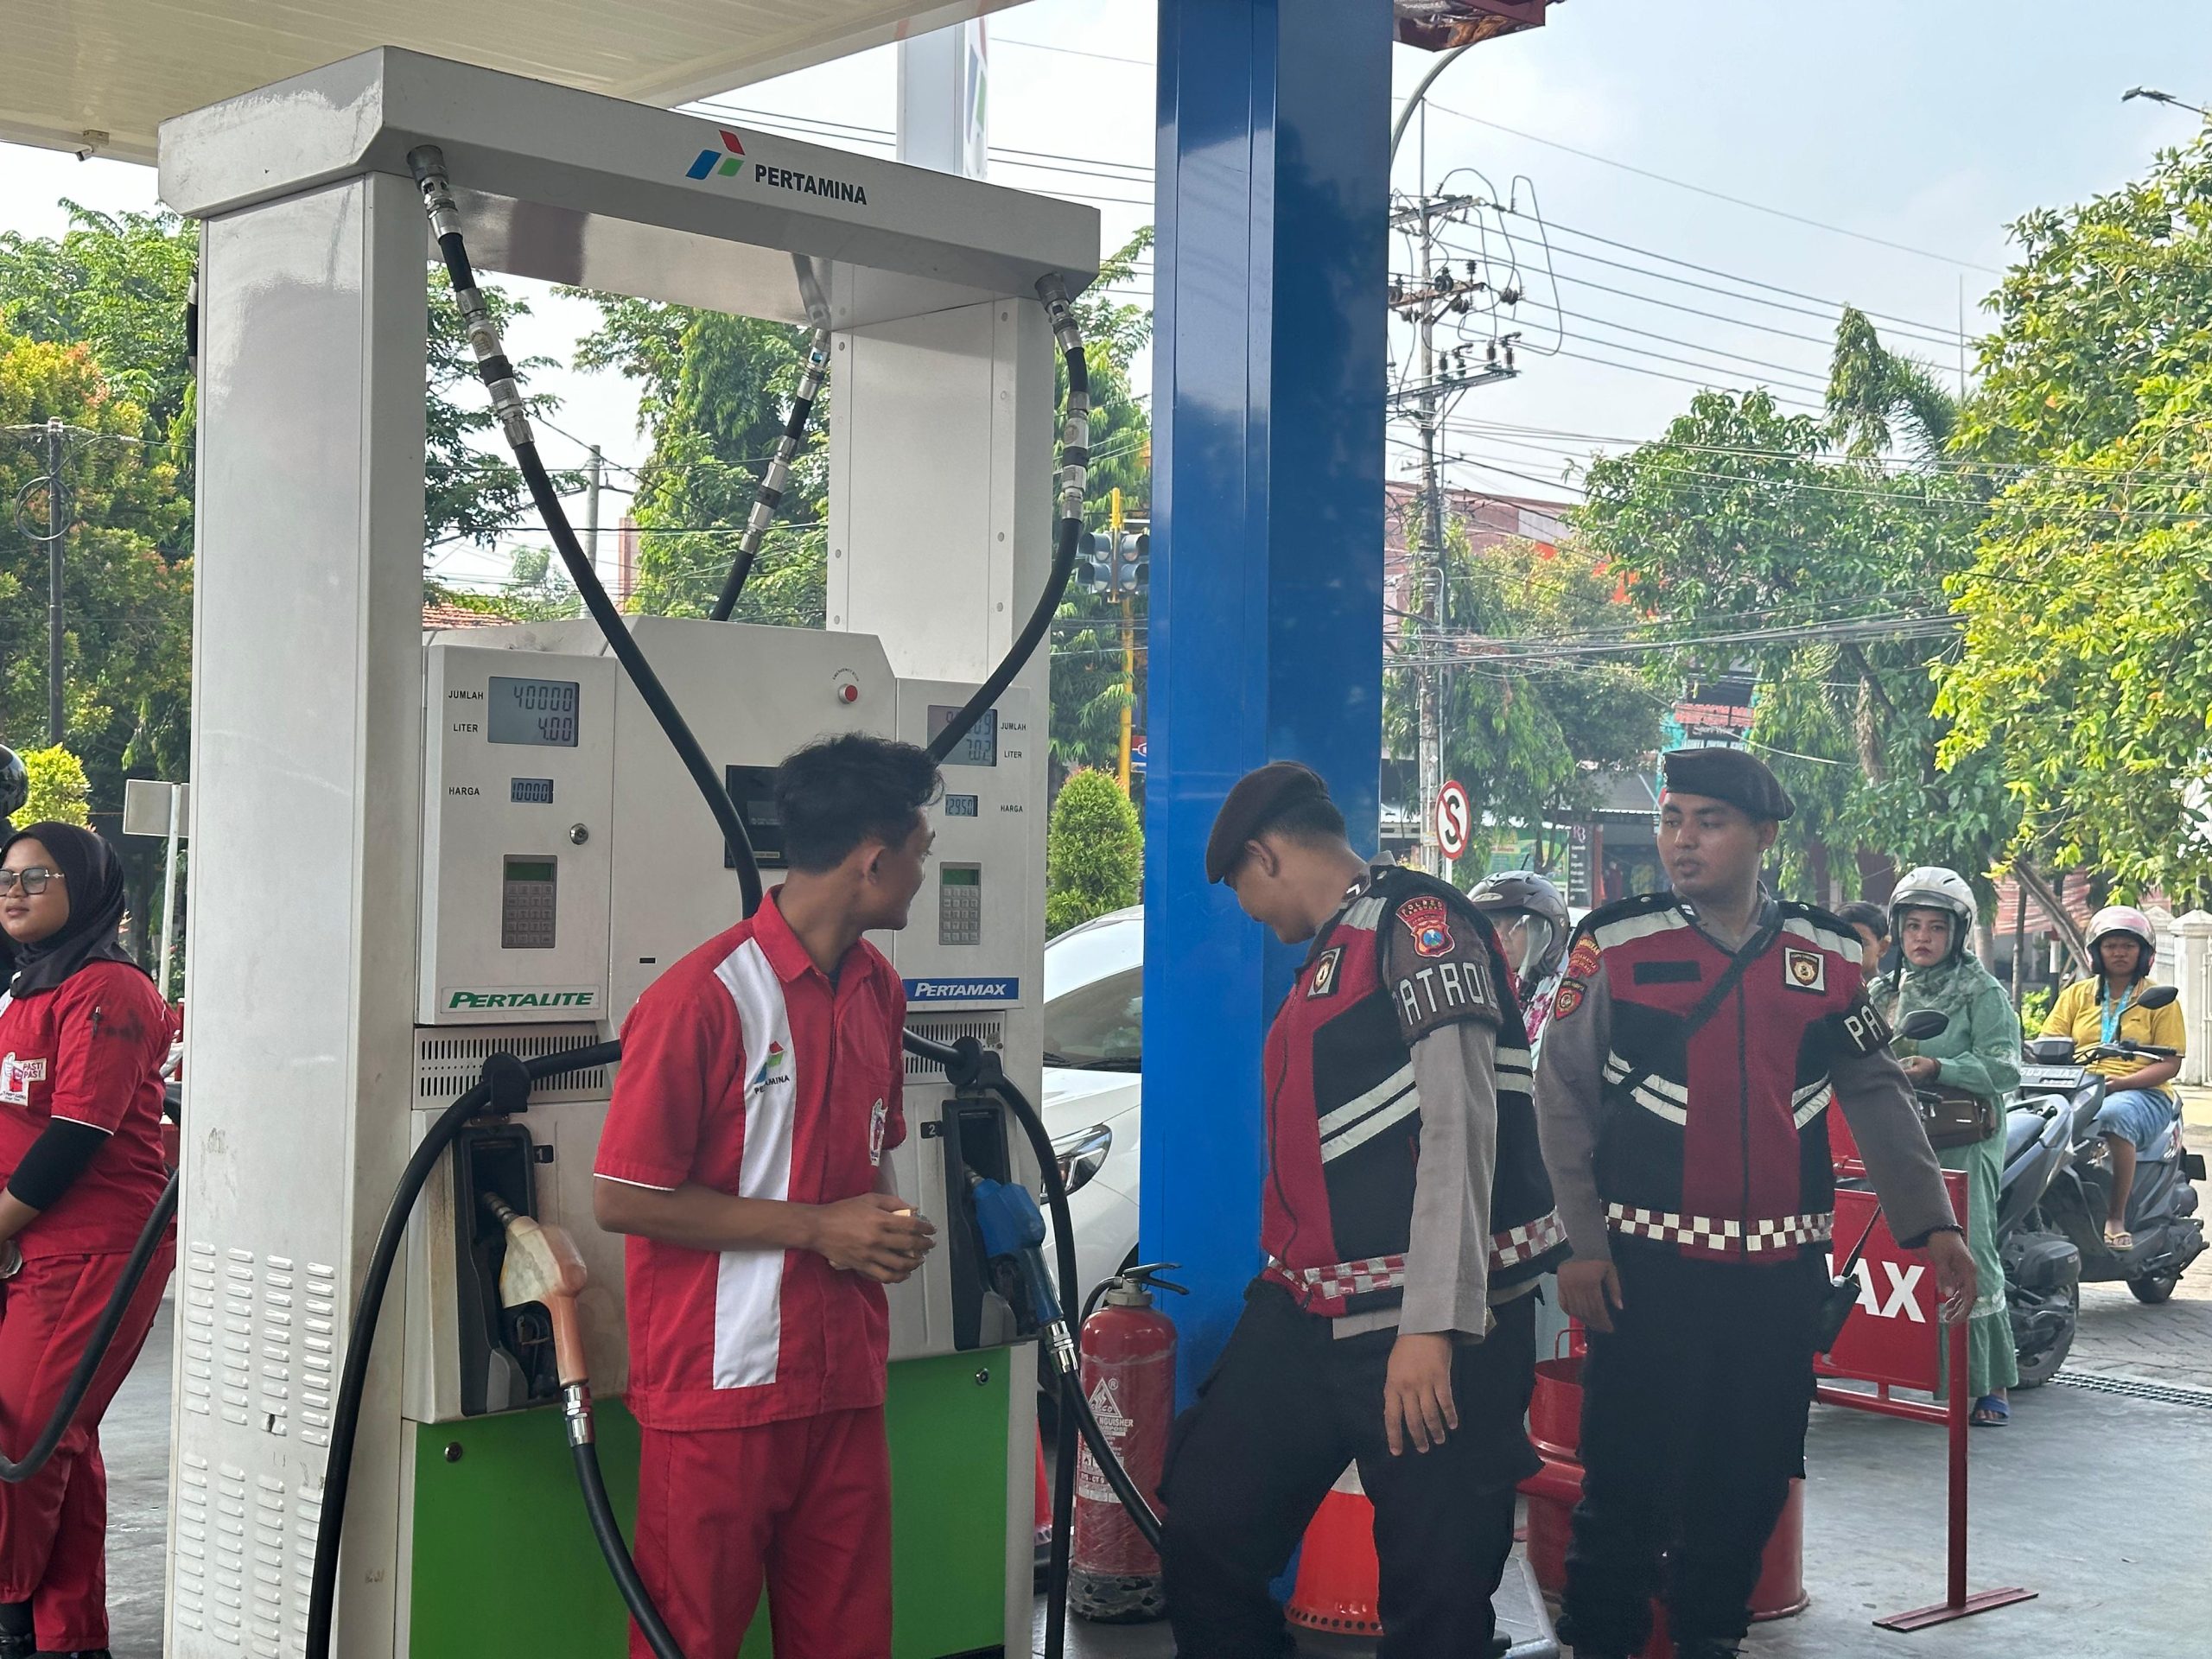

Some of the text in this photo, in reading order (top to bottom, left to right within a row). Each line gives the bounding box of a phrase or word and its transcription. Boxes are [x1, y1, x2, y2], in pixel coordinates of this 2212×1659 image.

[755, 163, 867, 206] PERTAMINA
[448, 690, 484, 700] JUMLAH
[514, 685, 574, 712] 40000
[453, 723, 479, 733] LITER
[538, 717, 573, 741] 4.00
[1001, 722, 1027, 731] JUMLAH
[448, 786, 480, 796] HARGA
[512, 782, 549, 802] 10000
[946, 798, 973, 815] 12950
[1001, 804, 1023, 813] HARGA
[914, 982, 1007, 997] PERTAMAX
[448, 991, 594, 1008] PERTALITE
[1844, 997, 1884, 1052] PA
[929, 1124, 936, 1135] 2
[536, 1148, 543, 1160] 1
[1825, 1253, 1926, 1324] AX
